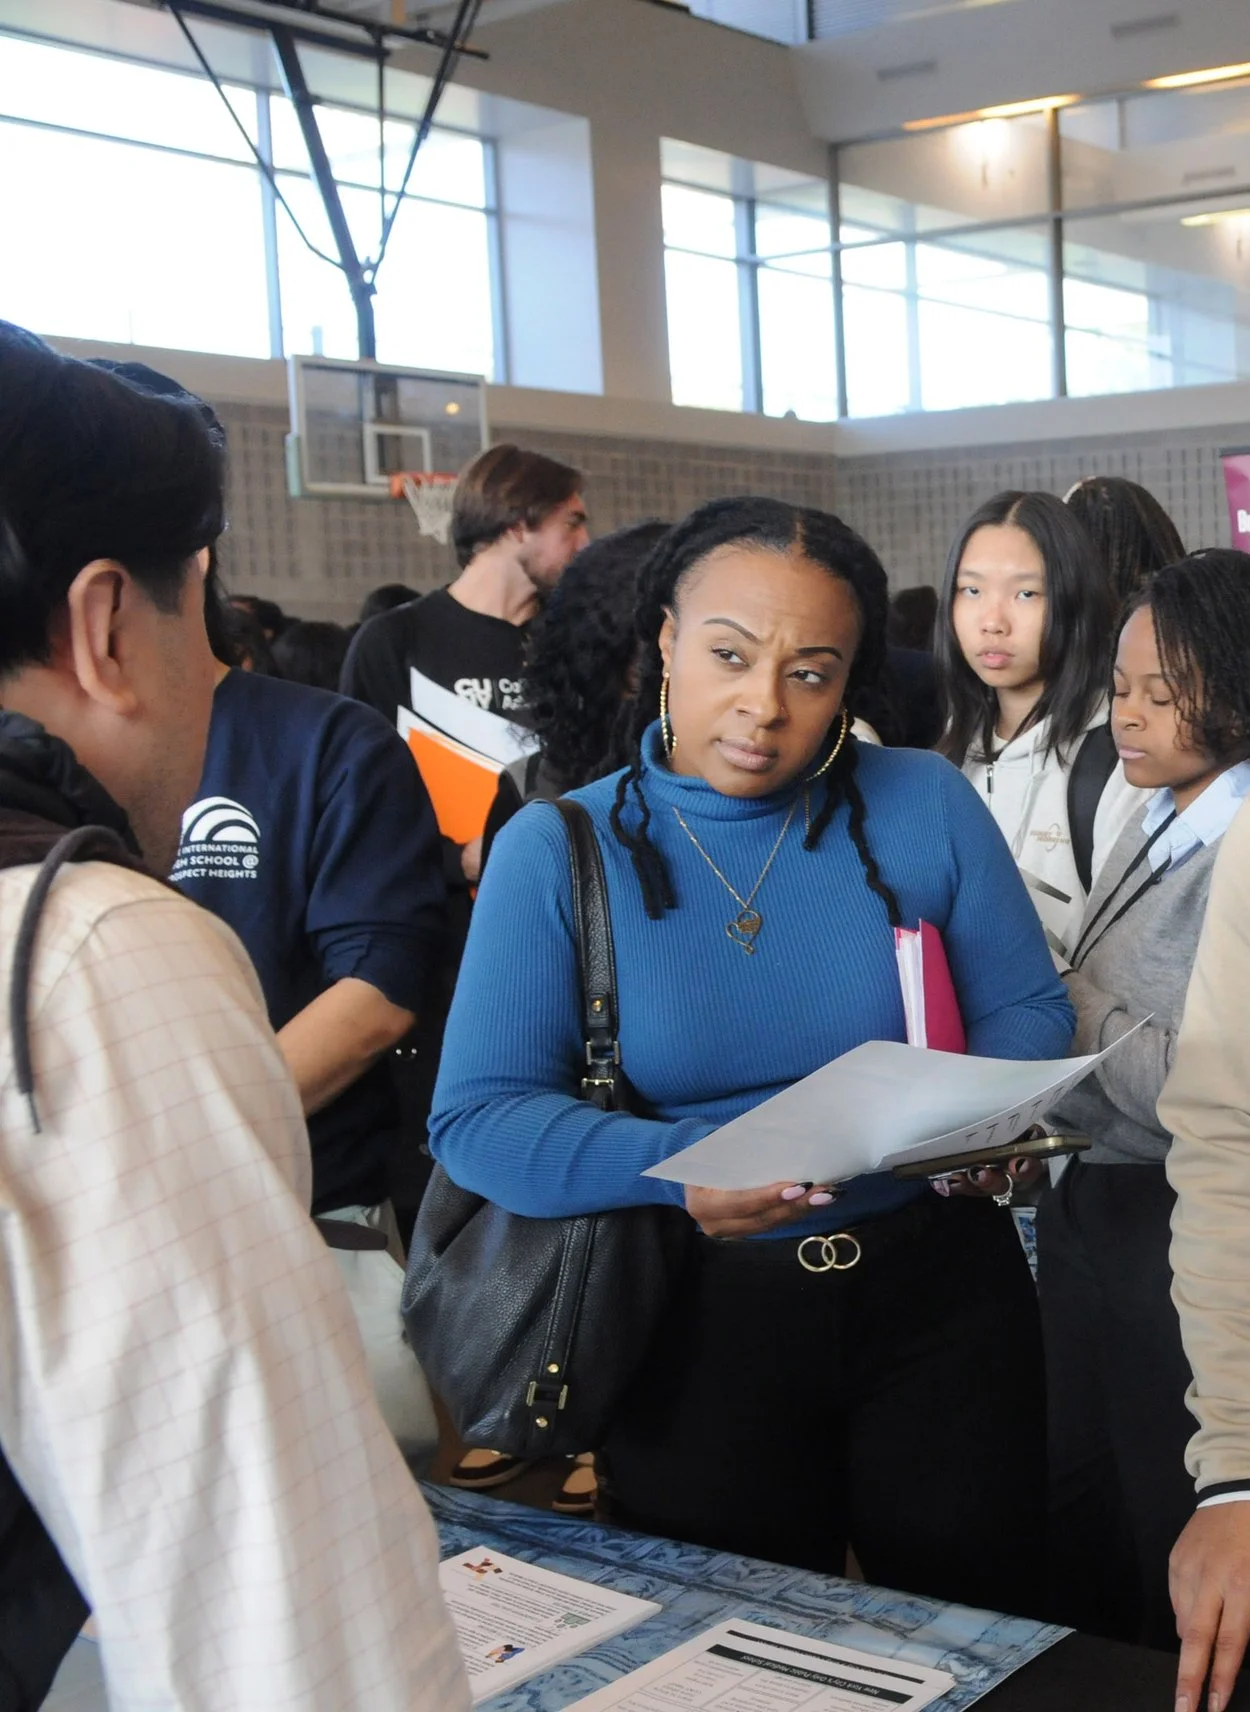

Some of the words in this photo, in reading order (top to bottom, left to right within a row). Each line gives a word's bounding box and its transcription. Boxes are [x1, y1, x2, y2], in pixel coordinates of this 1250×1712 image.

[182, 843, 259, 855] INTERNATIONAL
[190, 855, 239, 866] SCHOOL
[242, 854, 259, 869] @
[209, 868, 257, 879] HEIGHTS
